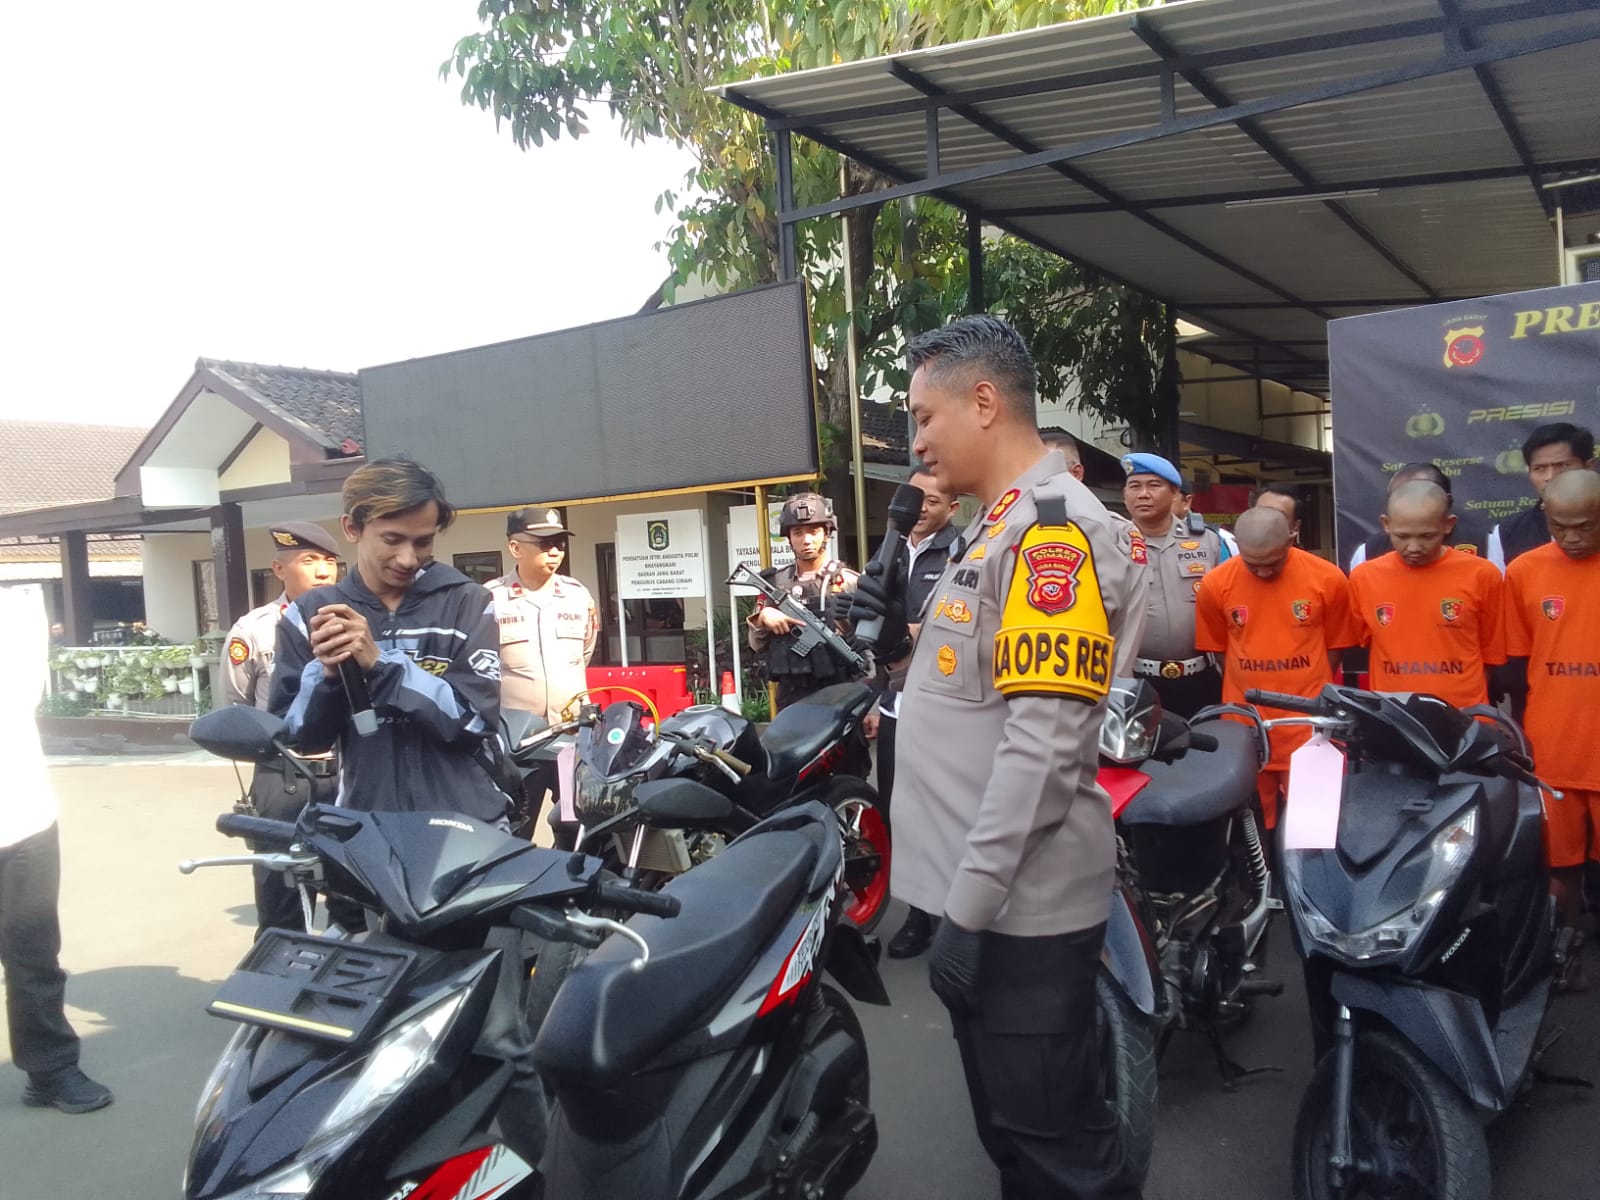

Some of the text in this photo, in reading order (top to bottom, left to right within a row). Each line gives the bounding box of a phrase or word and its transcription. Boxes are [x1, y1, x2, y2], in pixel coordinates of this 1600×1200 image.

[1467, 399, 1576, 425] PRESISI
[1464, 500, 1515, 510] Satuan
[1177, 551, 1207, 560] POLRI
[1238, 655, 1311, 672] TAHANAN
[1383, 661, 1464, 675] TAHANAN
[1545, 662, 1600, 676] TAHA
[428, 818, 474, 833] HONDA
[1440, 927, 1471, 964] HONDA
